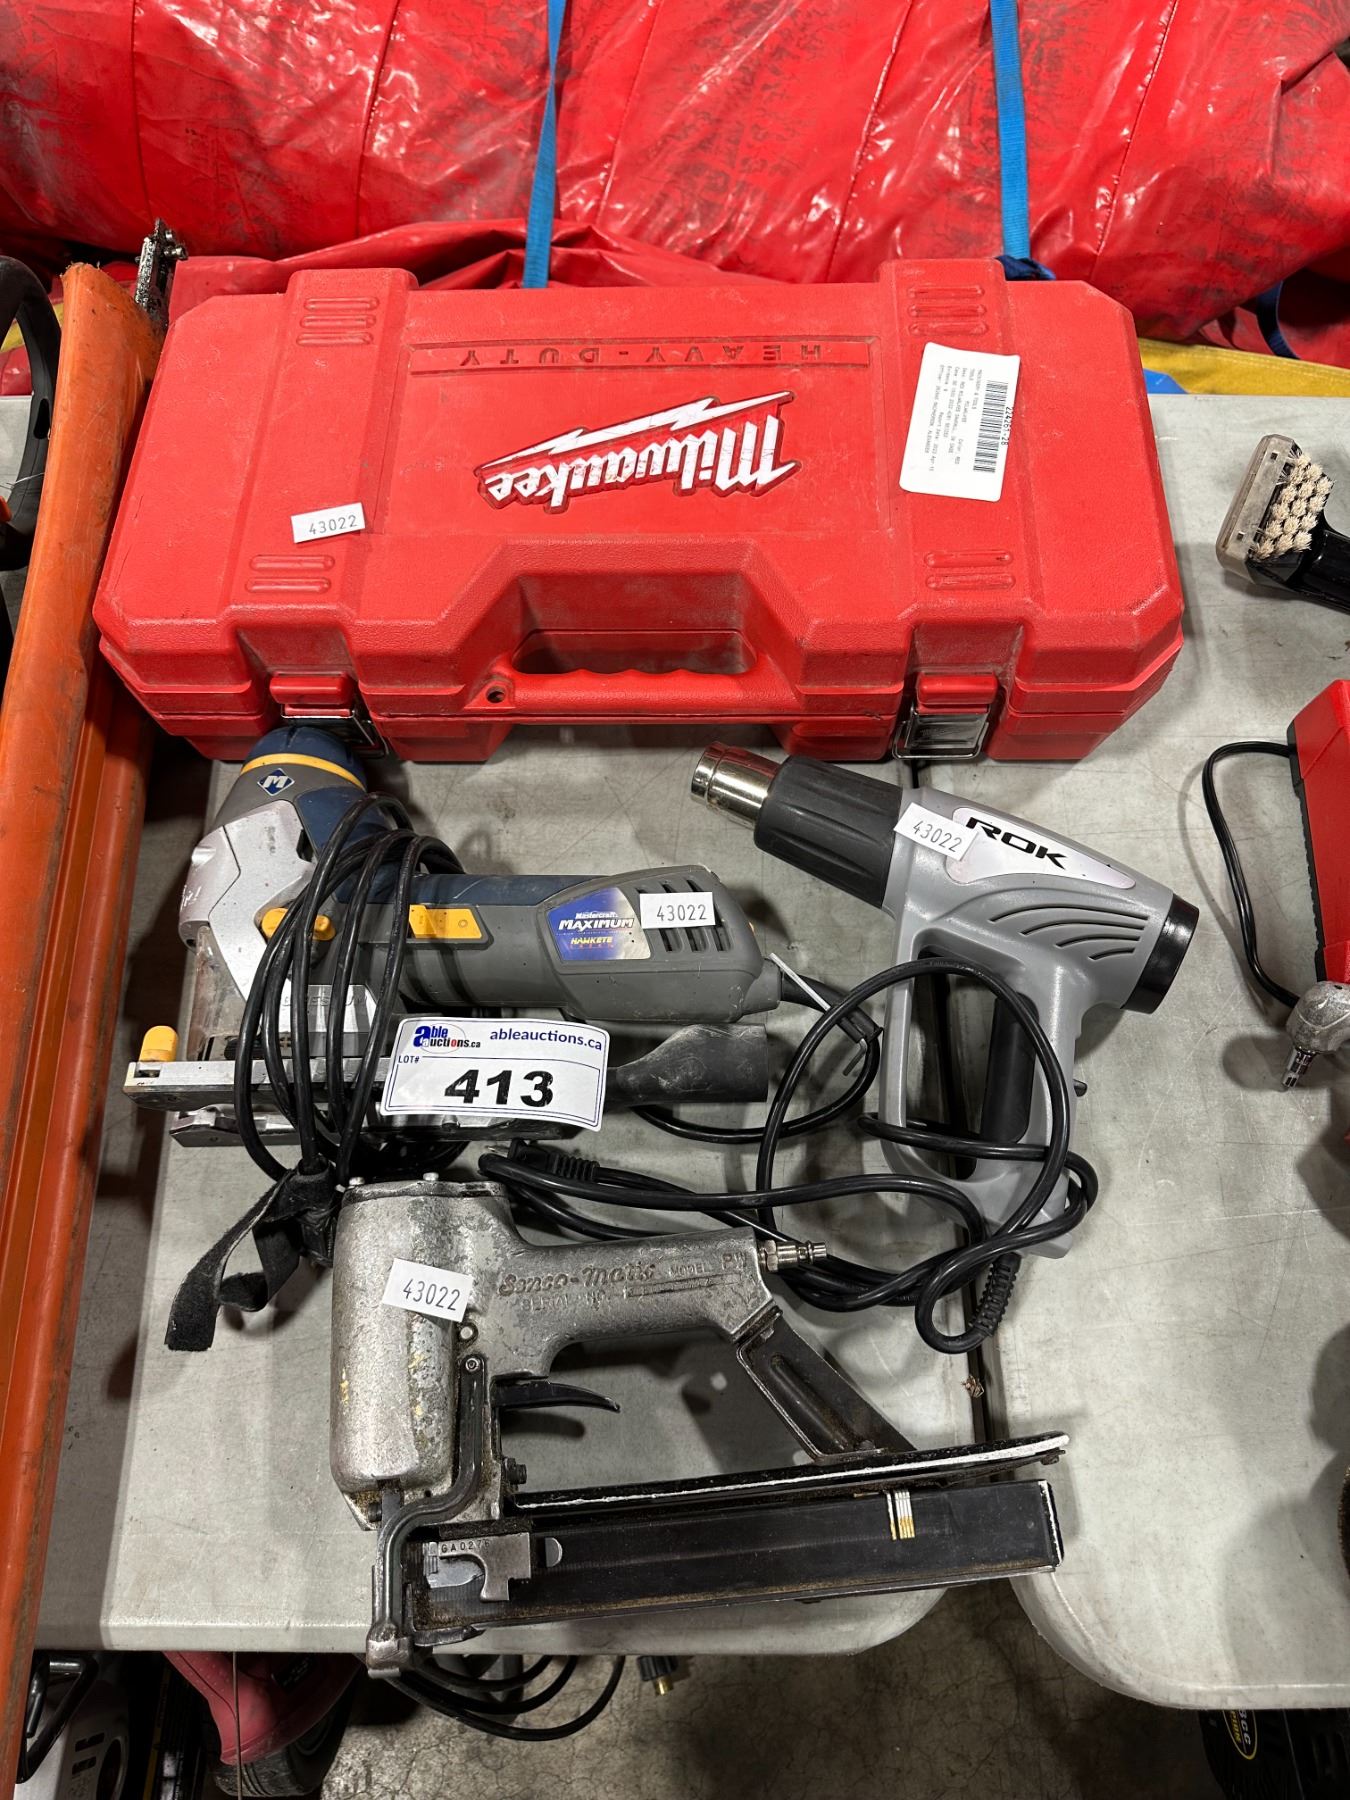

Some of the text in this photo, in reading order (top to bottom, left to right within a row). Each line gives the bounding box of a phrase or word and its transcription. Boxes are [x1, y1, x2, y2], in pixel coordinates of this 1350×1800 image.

[460, 344, 821, 366] HEAVY-DUTY
[484, 412, 797, 508] Milwaukee
[309, 515, 357, 535] 43022
[262, 775, 289, 788] M
[912, 819, 963, 853] 43022
[965, 816, 1069, 871] ROK
[656, 903, 707, 922] 43022
[558, 919, 634, 932] MAXIMUM
[490, 1028, 602, 1050] ableauctions.ca
[398, 1055, 420, 1064] LOT#
[444, 1069, 554, 1108] 413
[403, 1277, 462, 1311] 43022
